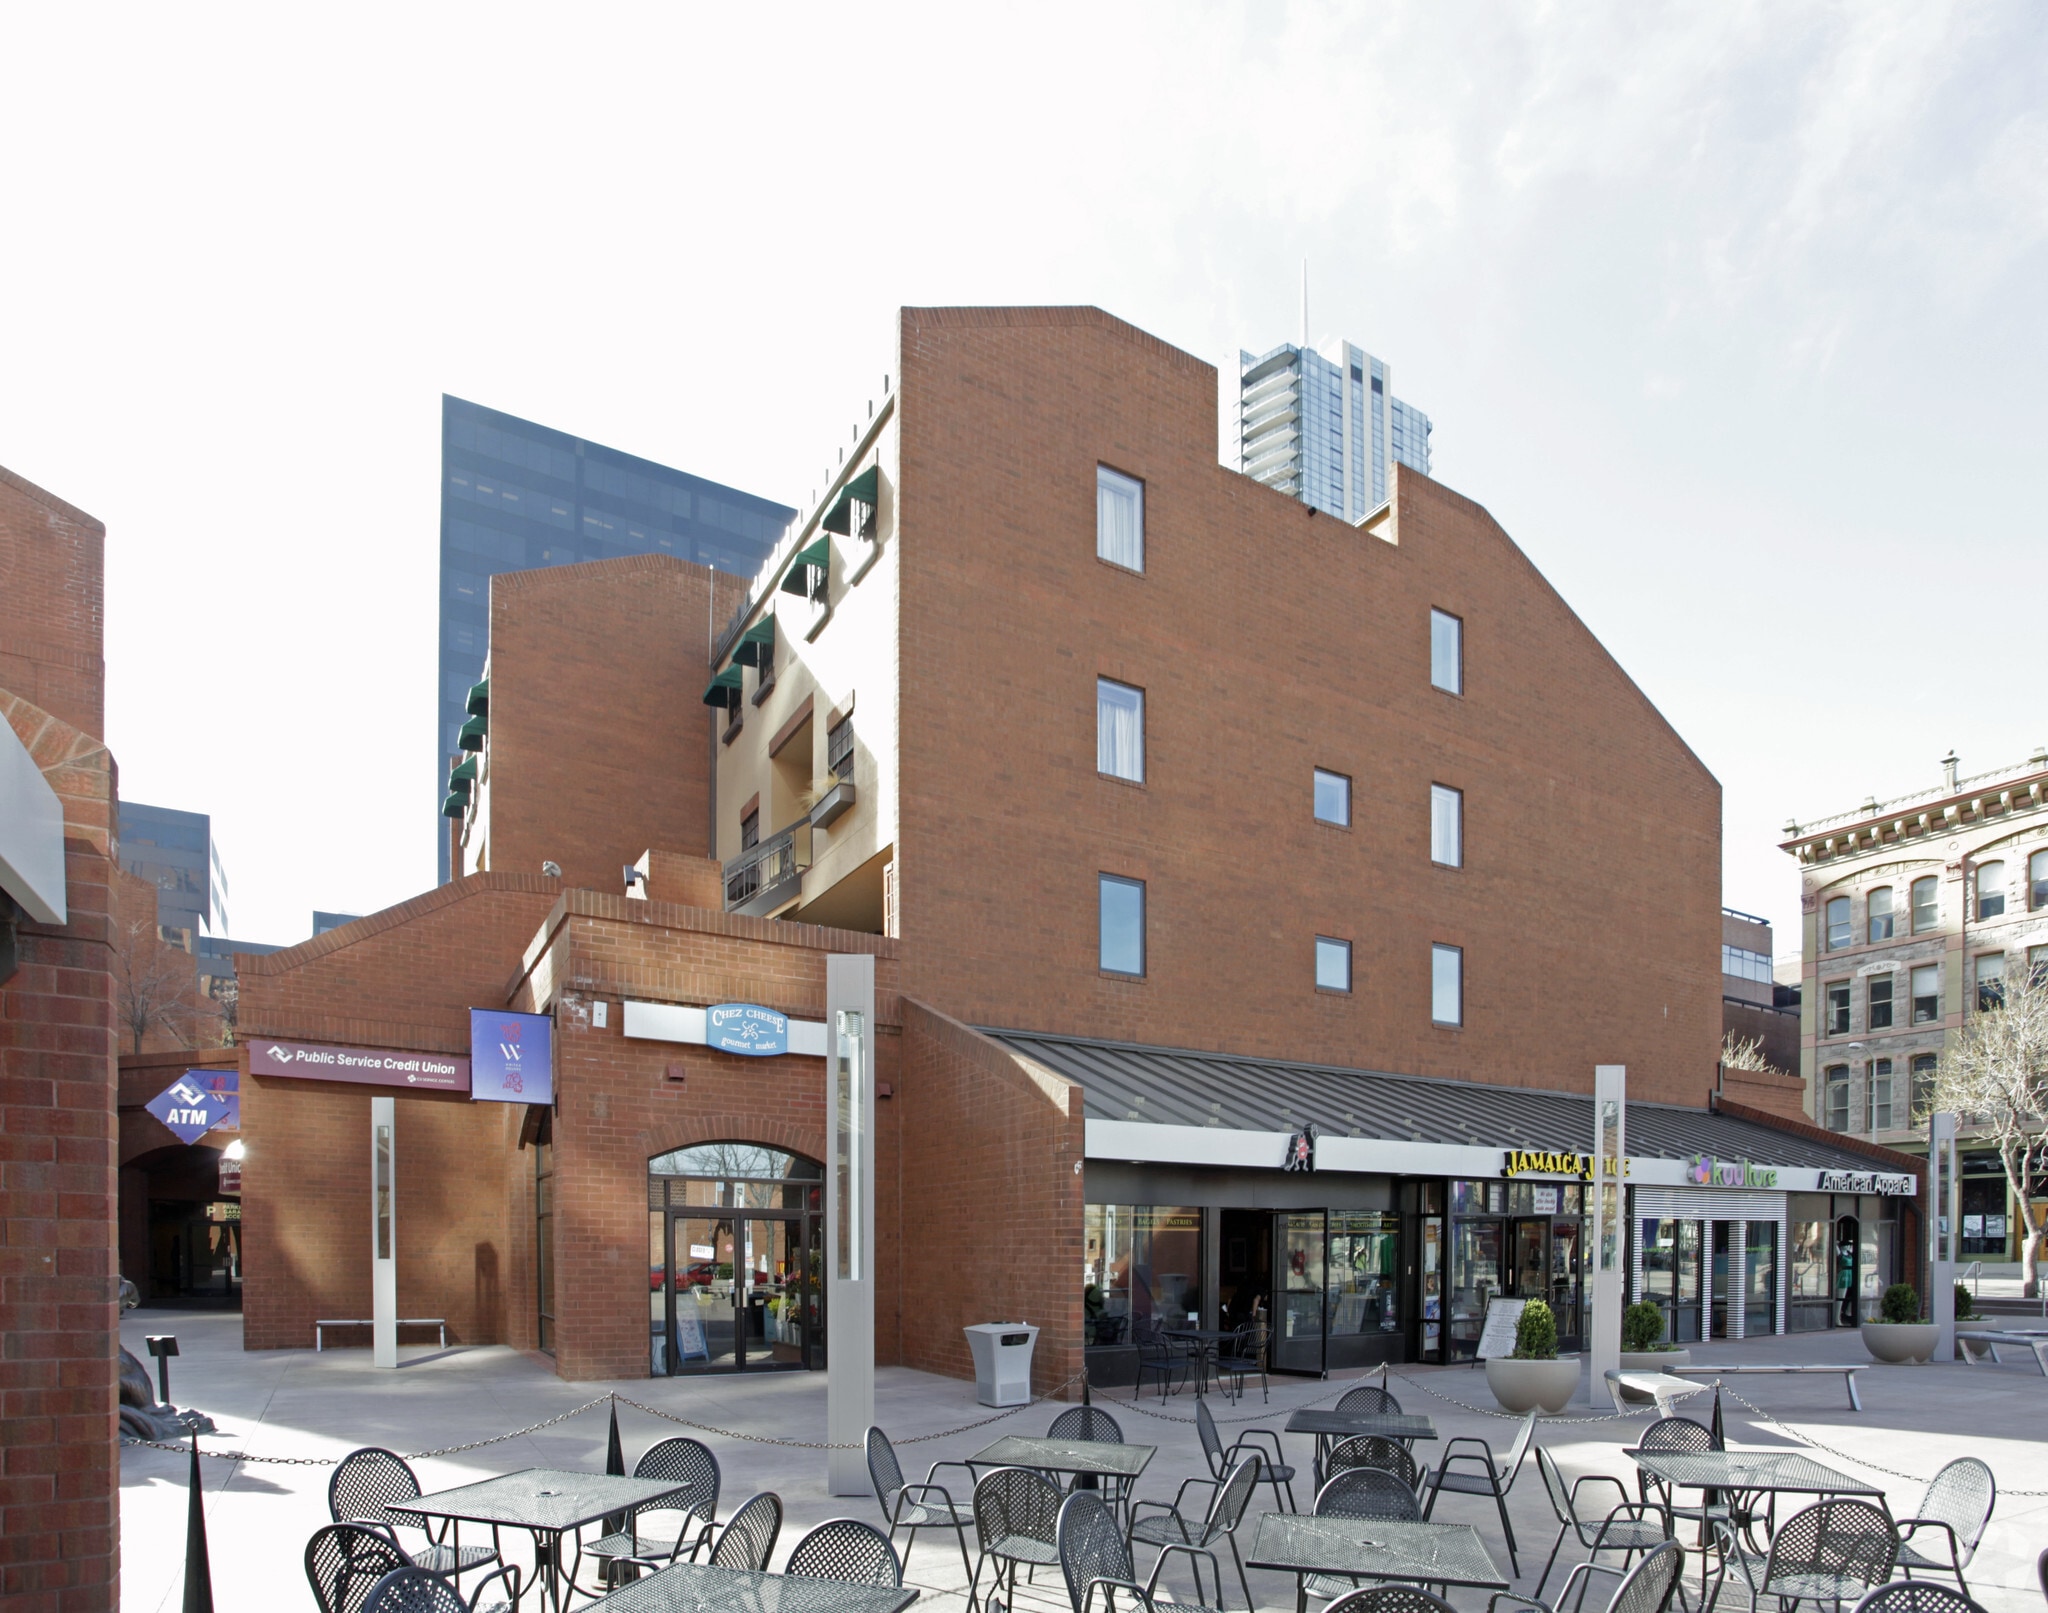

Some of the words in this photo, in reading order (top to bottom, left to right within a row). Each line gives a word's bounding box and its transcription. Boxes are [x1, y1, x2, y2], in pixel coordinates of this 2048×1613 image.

[712, 1009, 742, 1026] CHEZ
[746, 1010, 783, 1034] CHEESE
[721, 1037, 750, 1049] gourmet
[756, 1041, 776, 1049] market
[296, 1050, 334, 1064] Public
[337, 1053, 381, 1068] Service
[384, 1057, 420, 1072] Credit
[422, 1061, 455, 1074] Union
[166, 1109, 207, 1125] ATM
[1504, 1151, 1582, 1177] JAMAICA
[1584, 1156, 1630, 1180] JICE
[1713, 1155, 1778, 1187] kuulture
[1821, 1171, 1872, 1191] American
[1874, 1174, 1911, 1196] Apparel
[206, 1206, 216, 1216] P
[1166, 1217, 1193, 1226] PASTRIES
